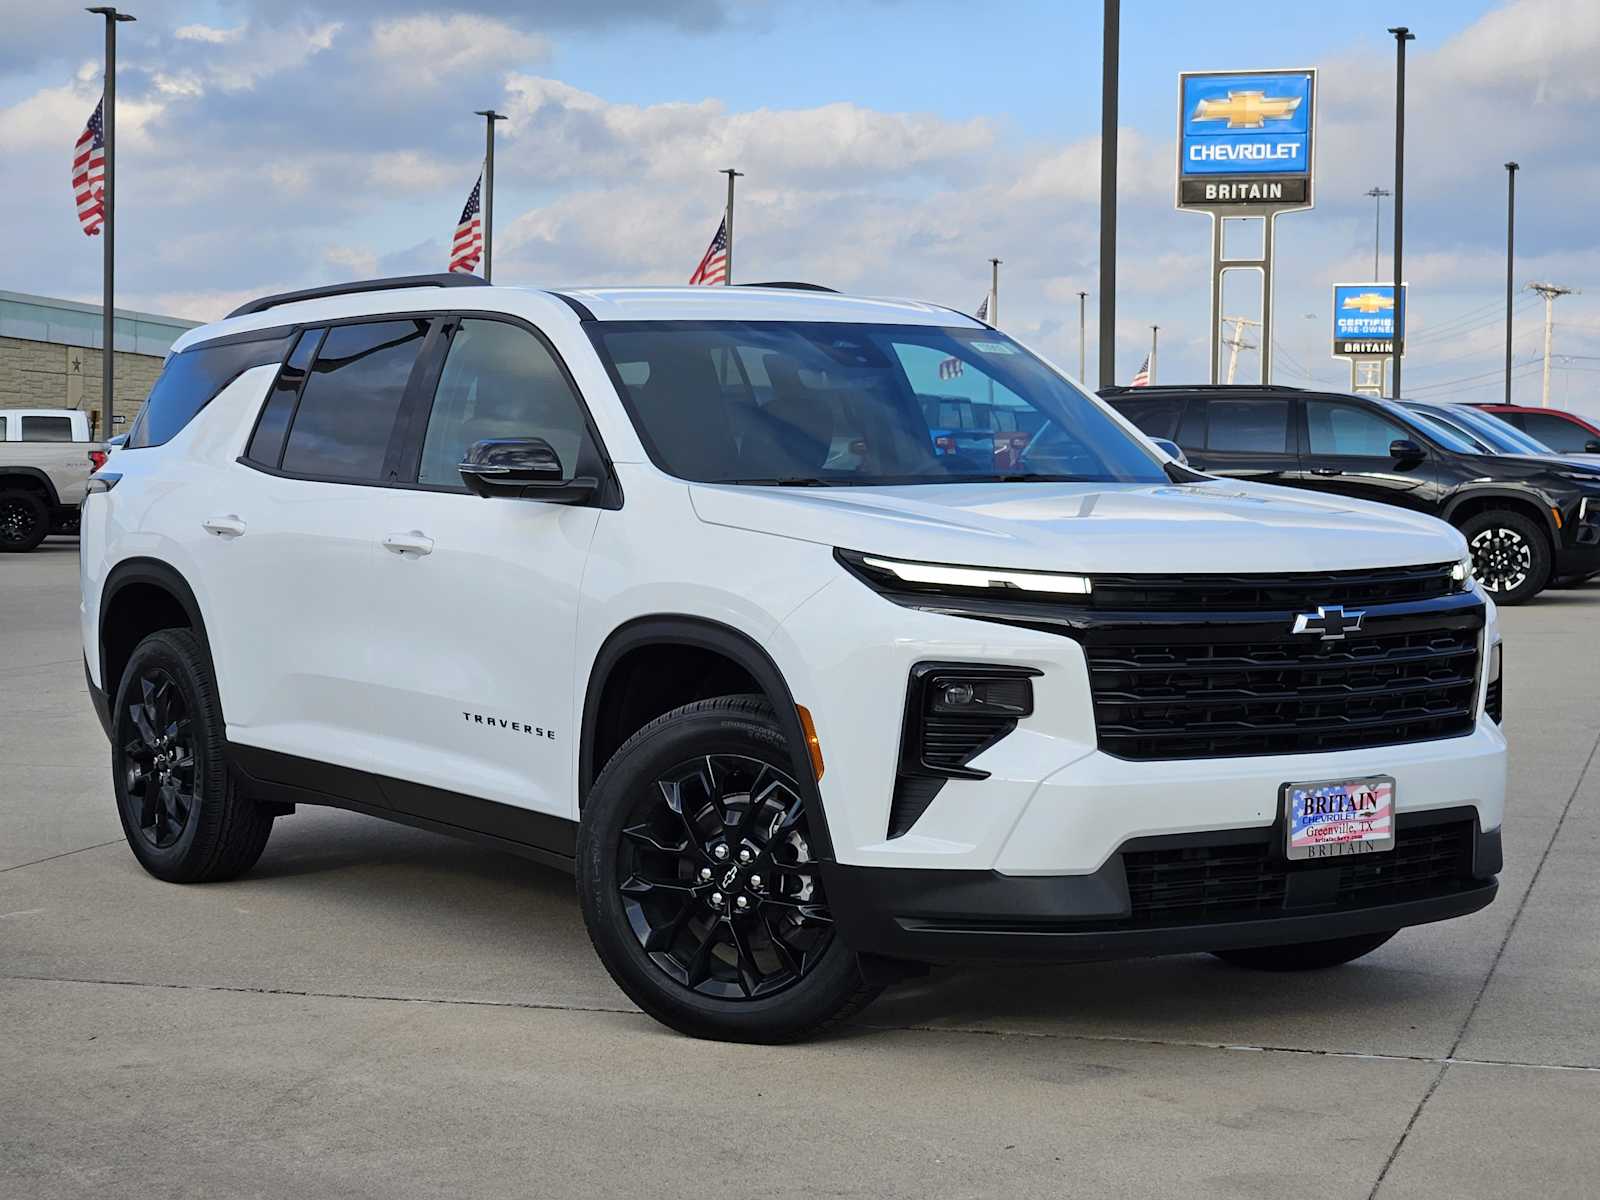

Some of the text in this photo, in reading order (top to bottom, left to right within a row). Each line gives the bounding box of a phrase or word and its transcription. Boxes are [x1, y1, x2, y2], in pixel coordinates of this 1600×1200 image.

[1189, 143, 1300, 161] CHEVROLET
[1205, 183, 1283, 200] BRITAIN
[1338, 318, 1393, 327] CERTIFIE
[1344, 342, 1393, 353] BRITAIN
[462, 711, 556, 740] TRAVERSE
[1303, 791, 1378, 816] BRITAIN
[1302, 812, 1357, 825] CHEVROLET
[1306, 820, 1374, 838] Greenville, TX
[1308, 839, 1375, 857] BRITAIN
